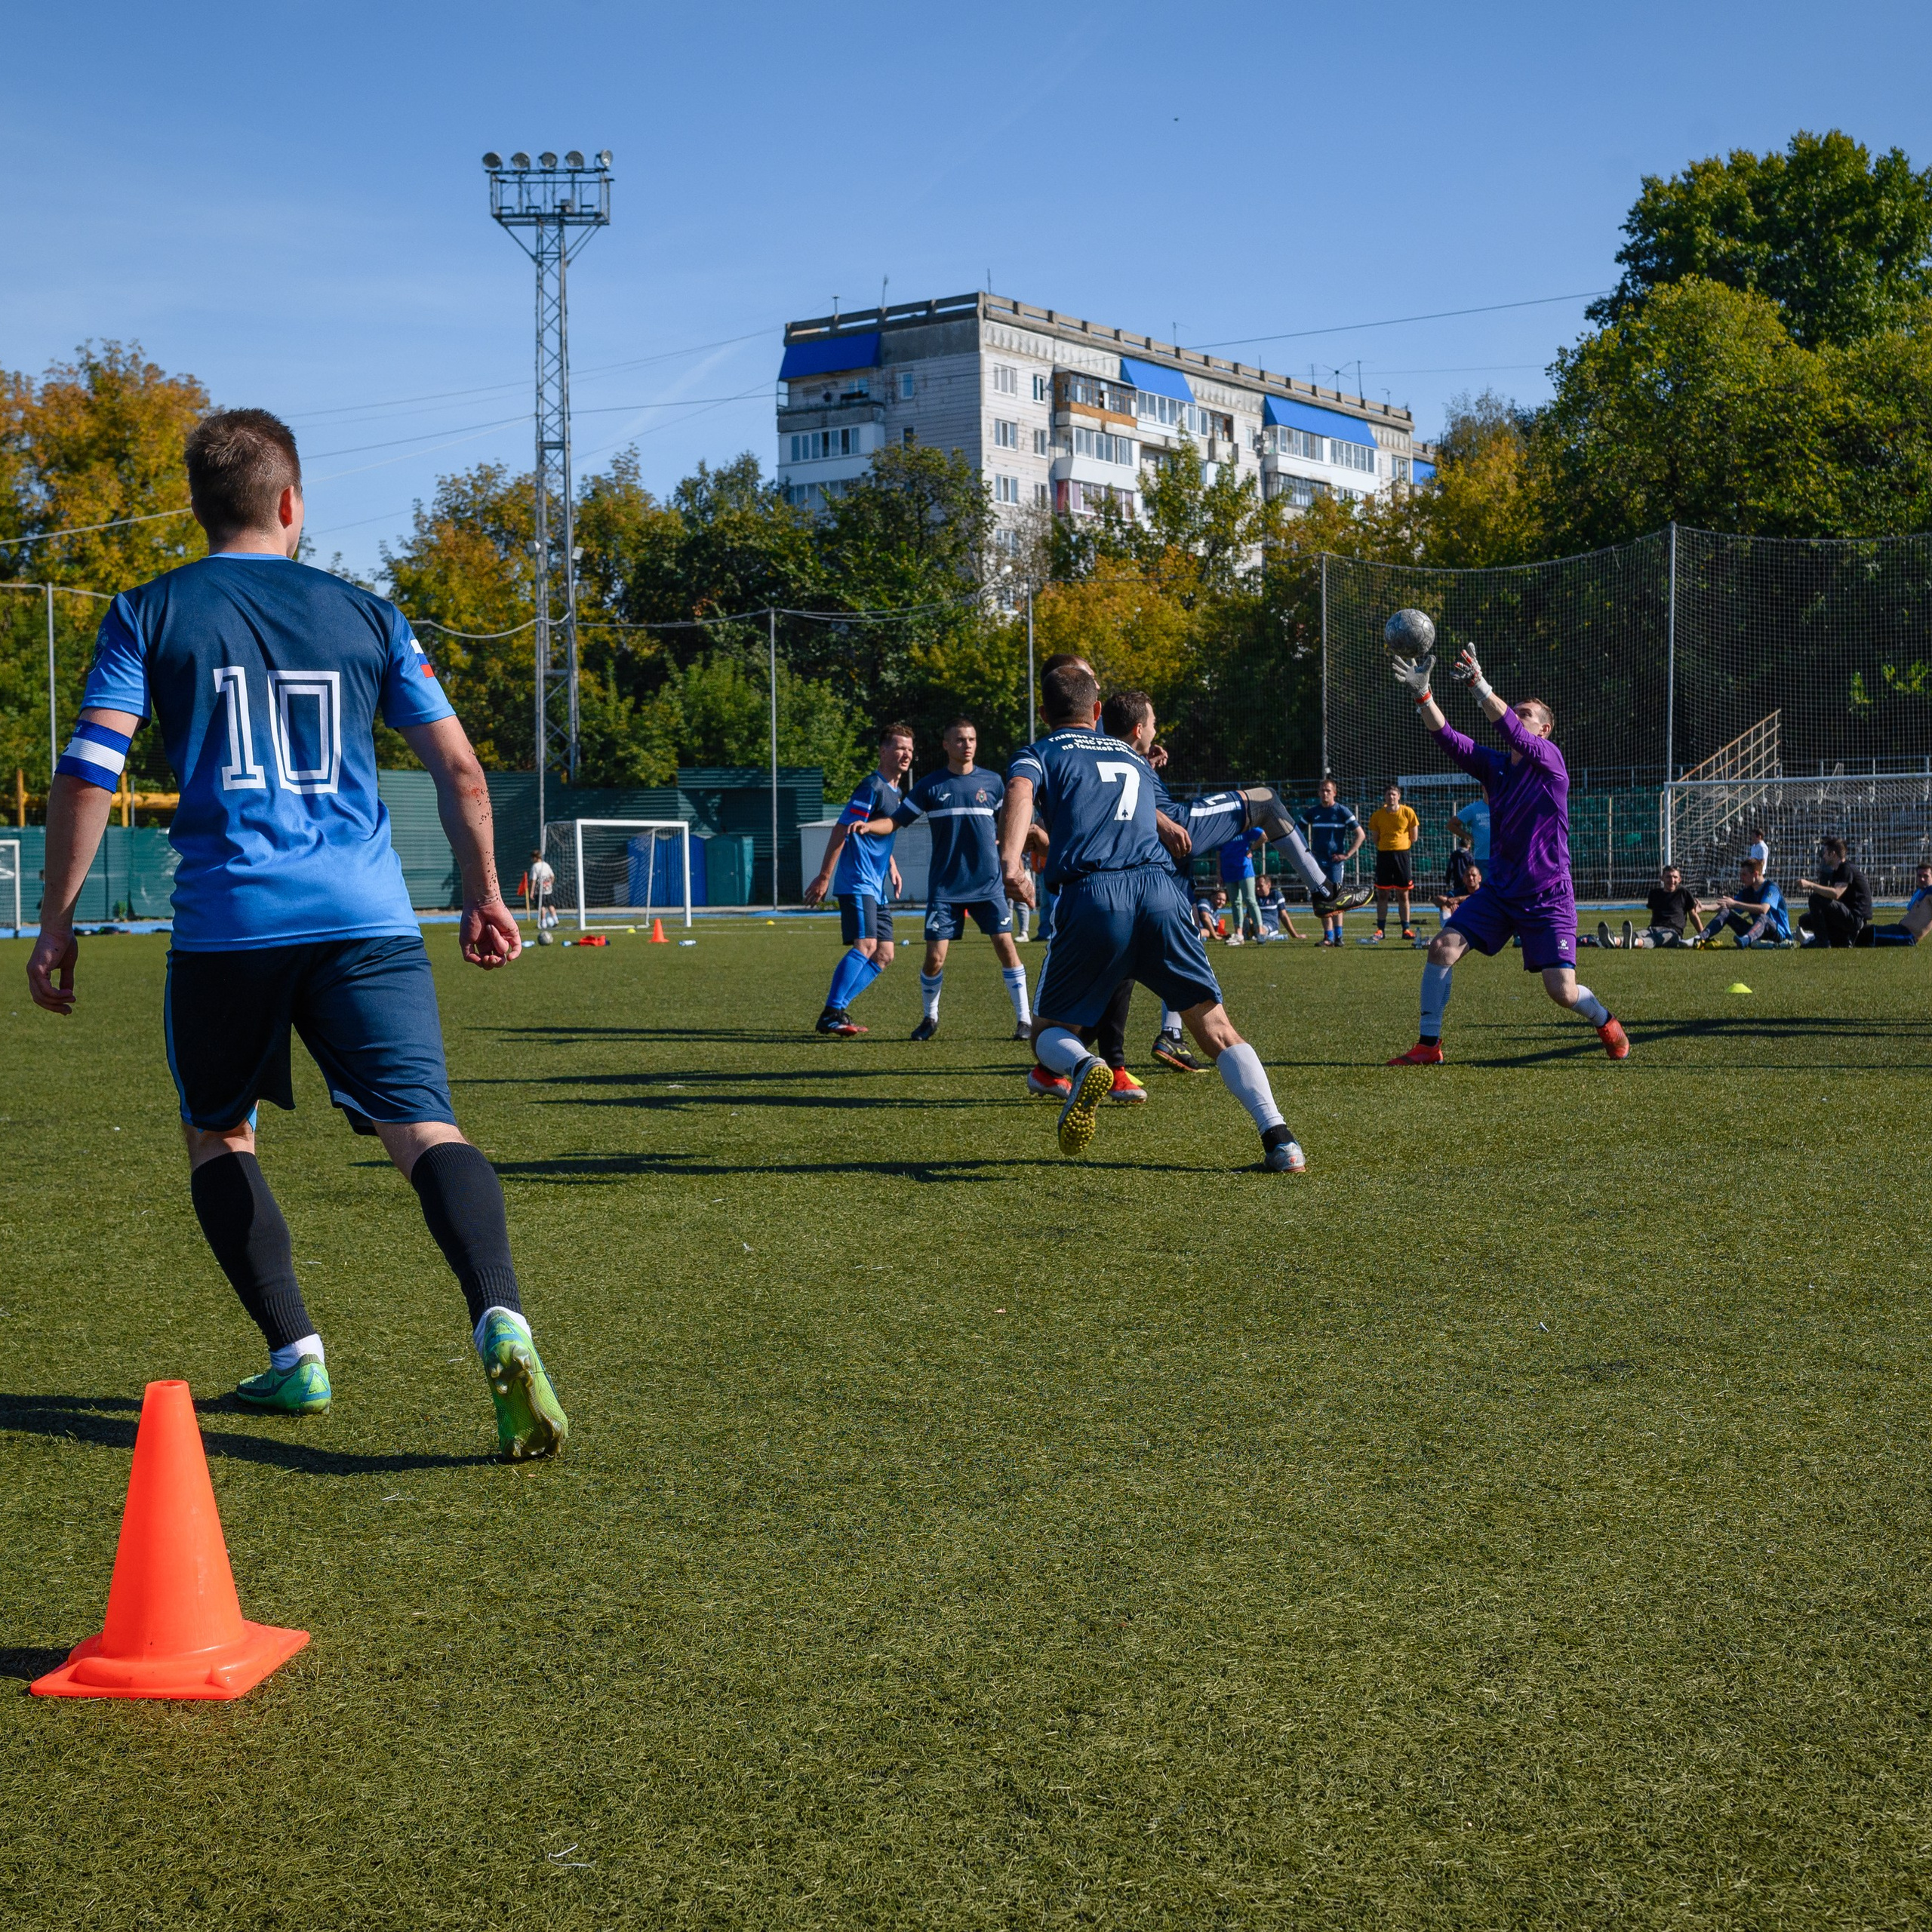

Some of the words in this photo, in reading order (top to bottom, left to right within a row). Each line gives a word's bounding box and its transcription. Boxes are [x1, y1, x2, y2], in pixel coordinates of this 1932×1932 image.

[213, 666, 341, 795] 10
[1048, 733, 1088, 743] Главное
[1074, 742, 1114, 751] Томской
[1096, 761, 1140, 821] 7
